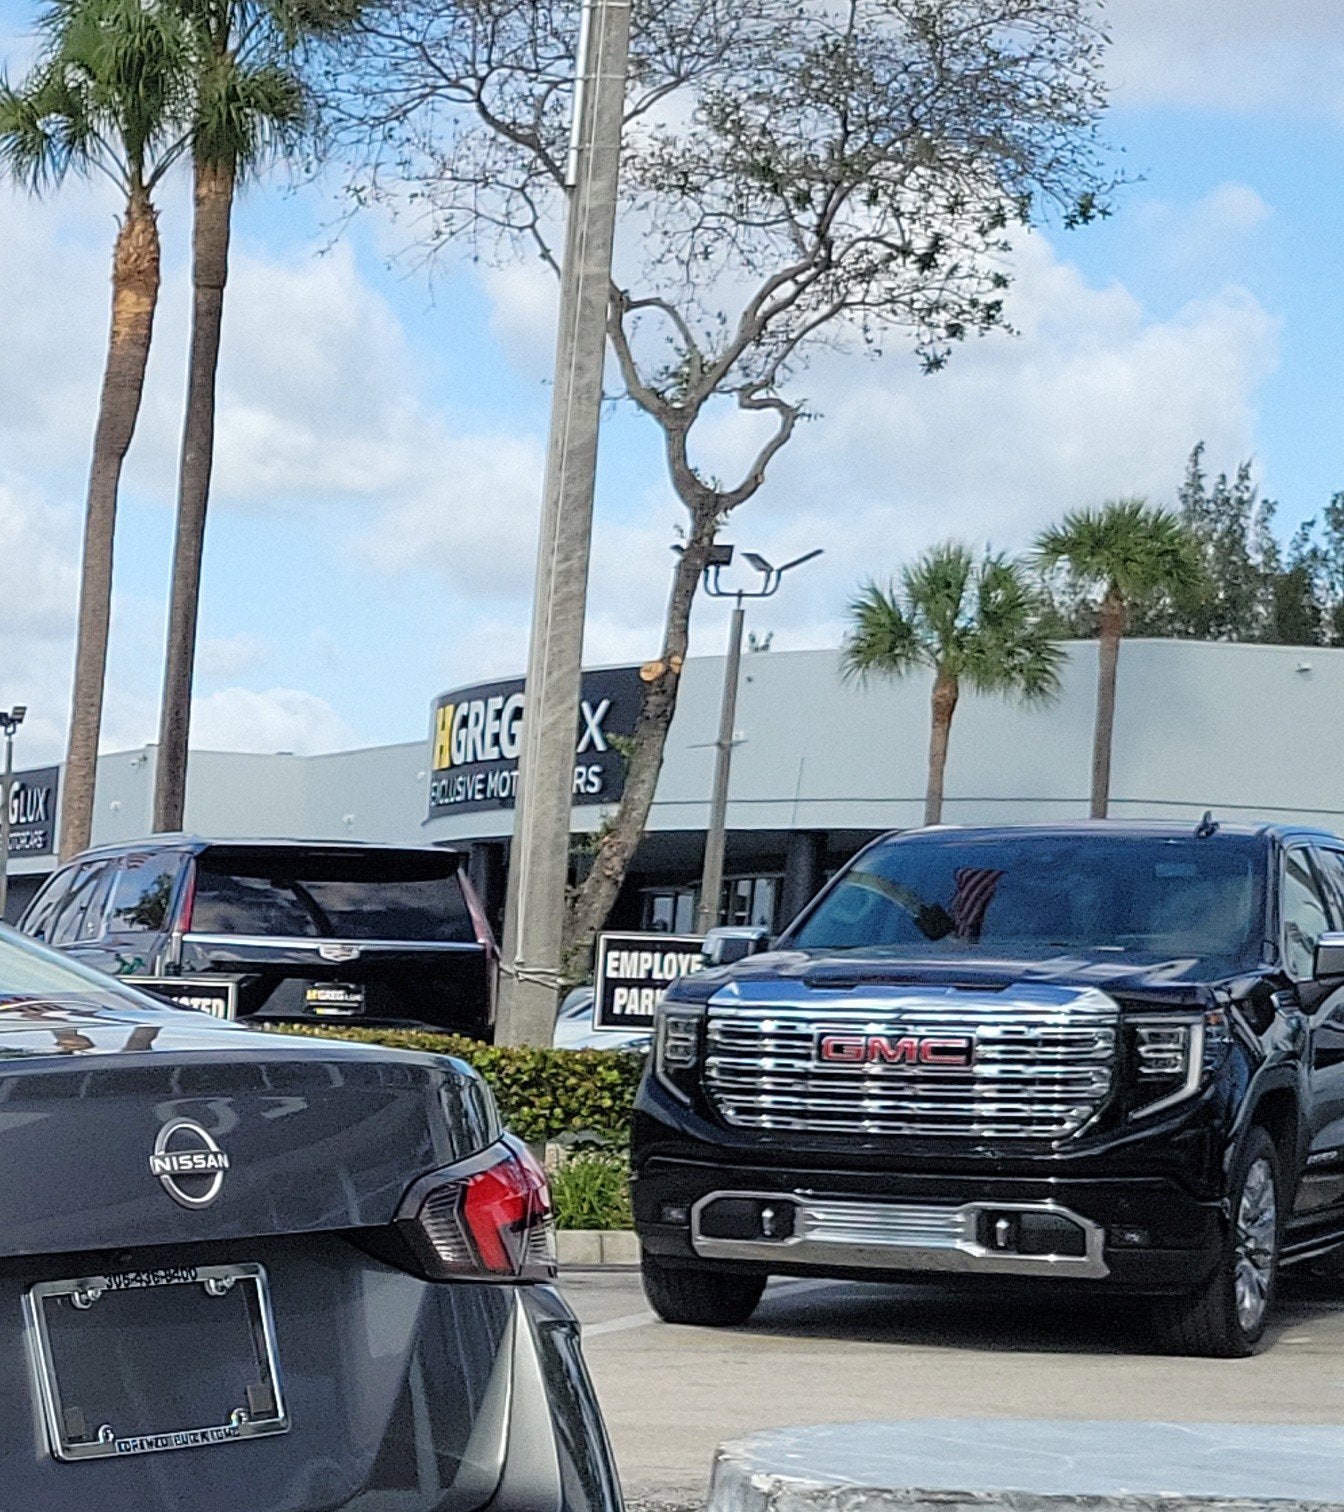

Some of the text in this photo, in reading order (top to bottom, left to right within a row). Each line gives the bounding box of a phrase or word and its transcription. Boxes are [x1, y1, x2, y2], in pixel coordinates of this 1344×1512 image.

[429, 773, 486, 808] EXCLUSIVE
[605, 950, 706, 981] EMPLOYE
[821, 1036, 969, 1064] GMC
[153, 1153, 230, 1173] NISSAN
